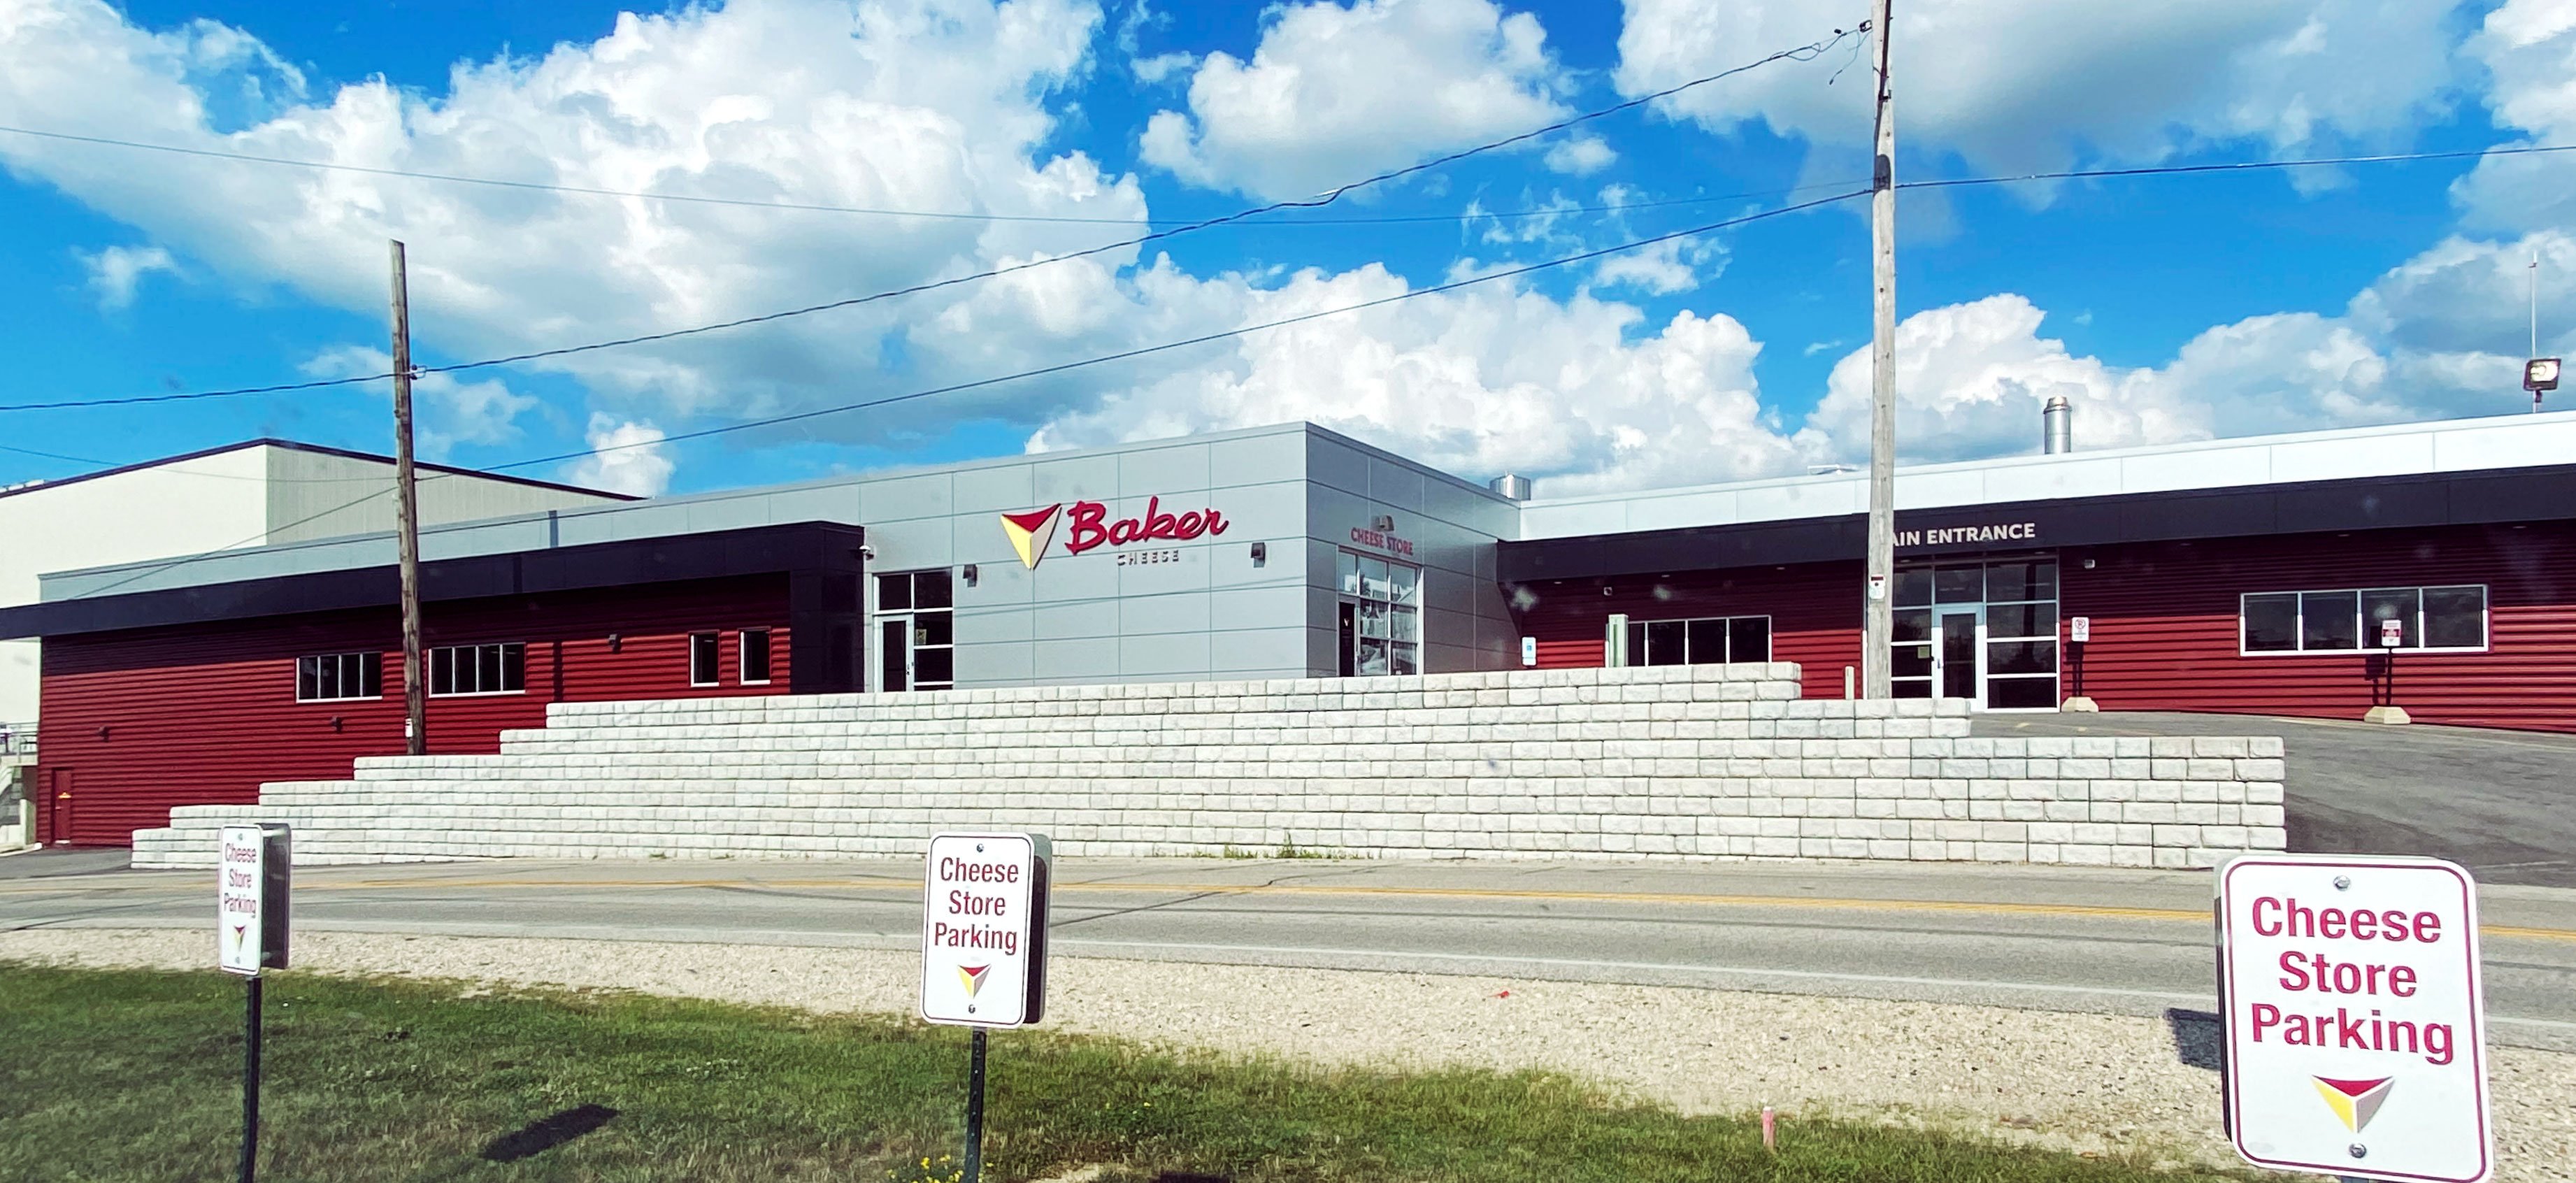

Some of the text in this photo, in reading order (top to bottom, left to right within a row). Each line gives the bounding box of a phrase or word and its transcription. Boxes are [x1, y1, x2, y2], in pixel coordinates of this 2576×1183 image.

[1064, 495, 1229, 556] Baker
[1926, 523, 2035, 545] ENTRANCE
[1351, 527, 1413, 556] CHEESE STORE
[1117, 550, 1179, 566] CHEESE
[225, 843, 257, 863] Cheese
[229, 868, 252, 889] Store
[940, 857, 1019, 883] Cheese
[224, 892, 256, 919] Parking
[949, 890, 1006, 916] Store
[2252, 896, 2441, 943] Cheese
[934, 922, 1017, 956] Parking
[2279, 951, 2417, 998] Store
[2252, 1003, 2454, 1066] Parking
